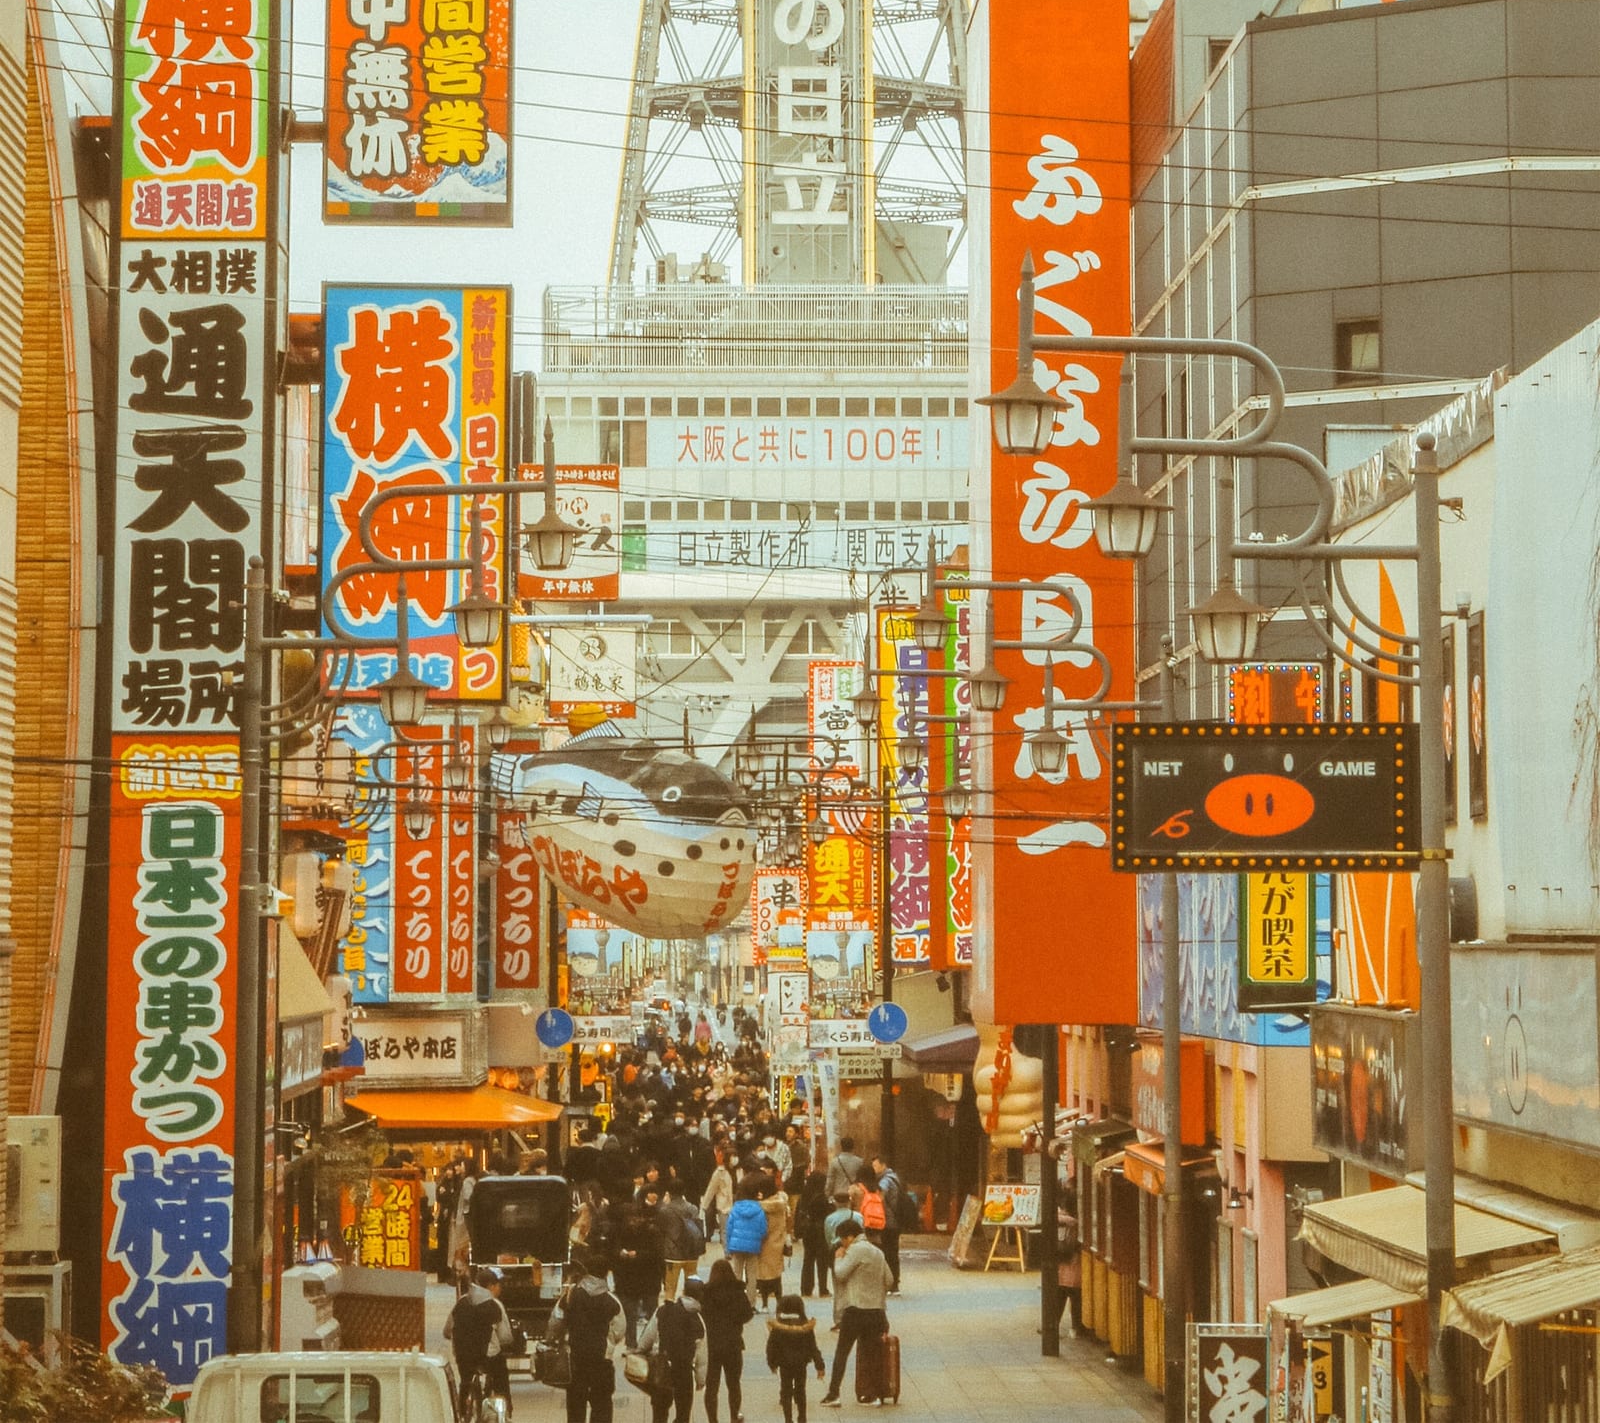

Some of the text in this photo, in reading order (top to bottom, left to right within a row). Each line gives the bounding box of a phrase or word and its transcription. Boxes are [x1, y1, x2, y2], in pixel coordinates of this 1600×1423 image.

[135, 183, 254, 227] 通天閣店
[127, 249, 257, 295] 大相撲
[470, 295, 497, 406] 新世界
[125, 303, 254, 654] 通天閣
[335, 308, 453, 621] 横綱
[466, 416, 499, 689] 日本一の串つ
[678, 529, 809, 567] 日立製作所
[542, 580, 594, 594] 年中無休
[121, 660, 244, 729] 場所
[128, 751, 241, 792] 新世界
[1143, 761, 1183, 776] NET
[1319, 761, 1376, 776] GAME
[814, 838, 851, 911] 通天
[405, 850, 433, 978] てっちり
[451, 850, 470, 978] てっちり
[502, 853, 534, 981] てっちり
[140, 806, 221, 1134] 日本一の串かつ
[361, 1036, 457, 1060] ぼらや本店
[574, 1028, 612, 1038] ら寿司
[383, 1183, 414, 1267] 24時間
[117, 1151, 234, 1375] 横綱
